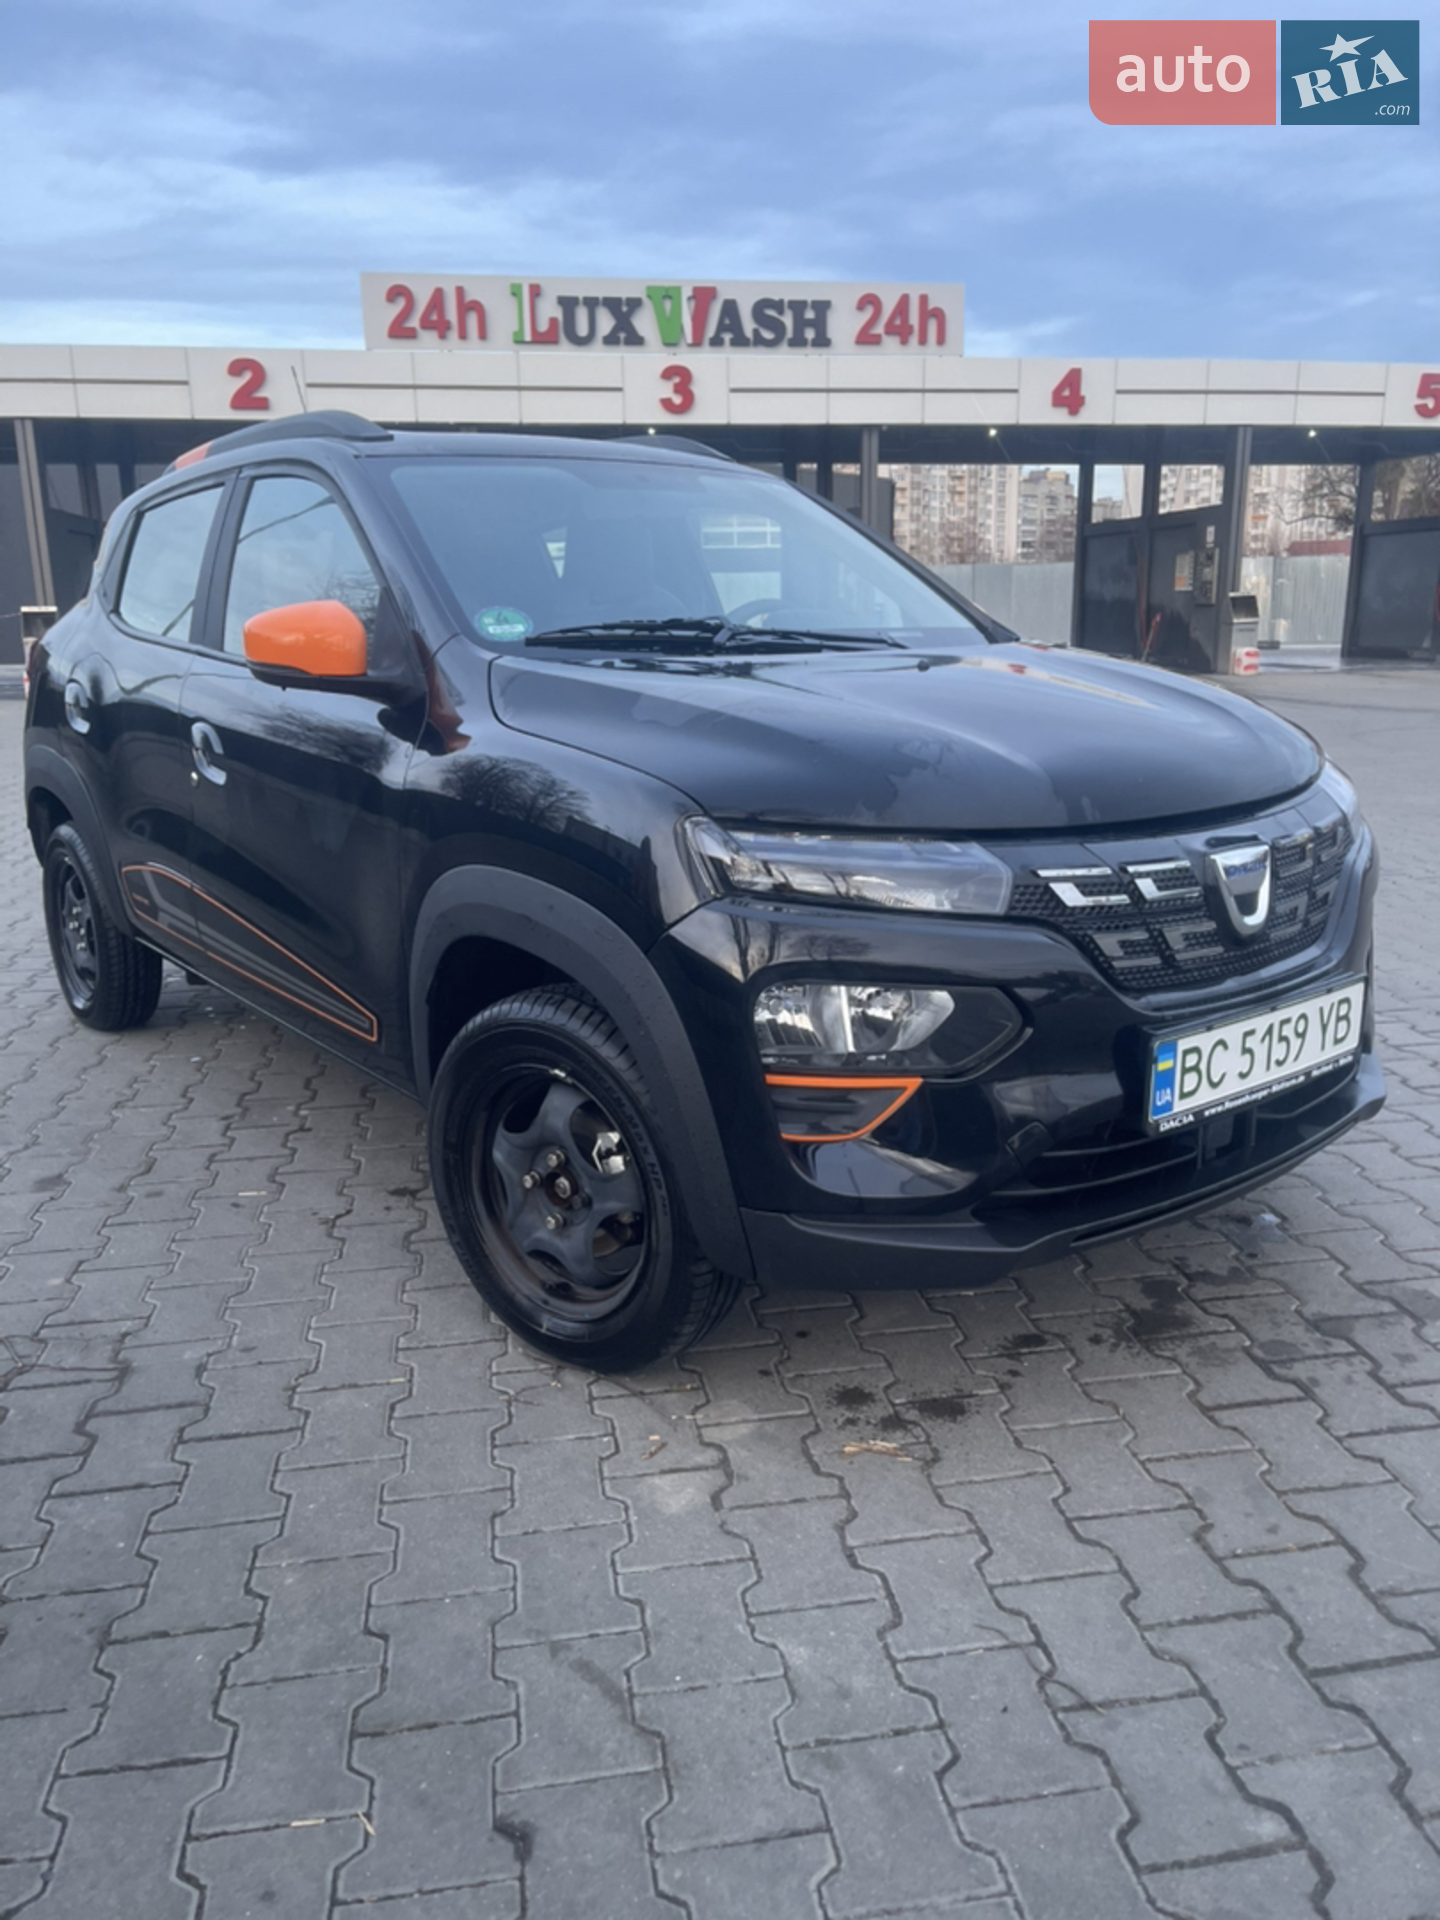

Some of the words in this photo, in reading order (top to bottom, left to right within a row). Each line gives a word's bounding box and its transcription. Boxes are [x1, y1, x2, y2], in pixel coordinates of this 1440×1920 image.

[384, 283, 488, 341] 24h
[854, 293, 947, 347] 24h
[227, 357, 270, 410] 2
[659, 364, 696, 415] 3
[1051, 367, 1085, 416] 4
[1414, 372, 1440, 419] 5
[1178, 1038, 1229, 1101] BC
[1237, 1012, 1309, 1080] 5159
[1319, 996, 1352, 1052] YB
[1155, 1087, 1173, 1107] UA
[1159, 1113, 1196, 1132] DACIA
